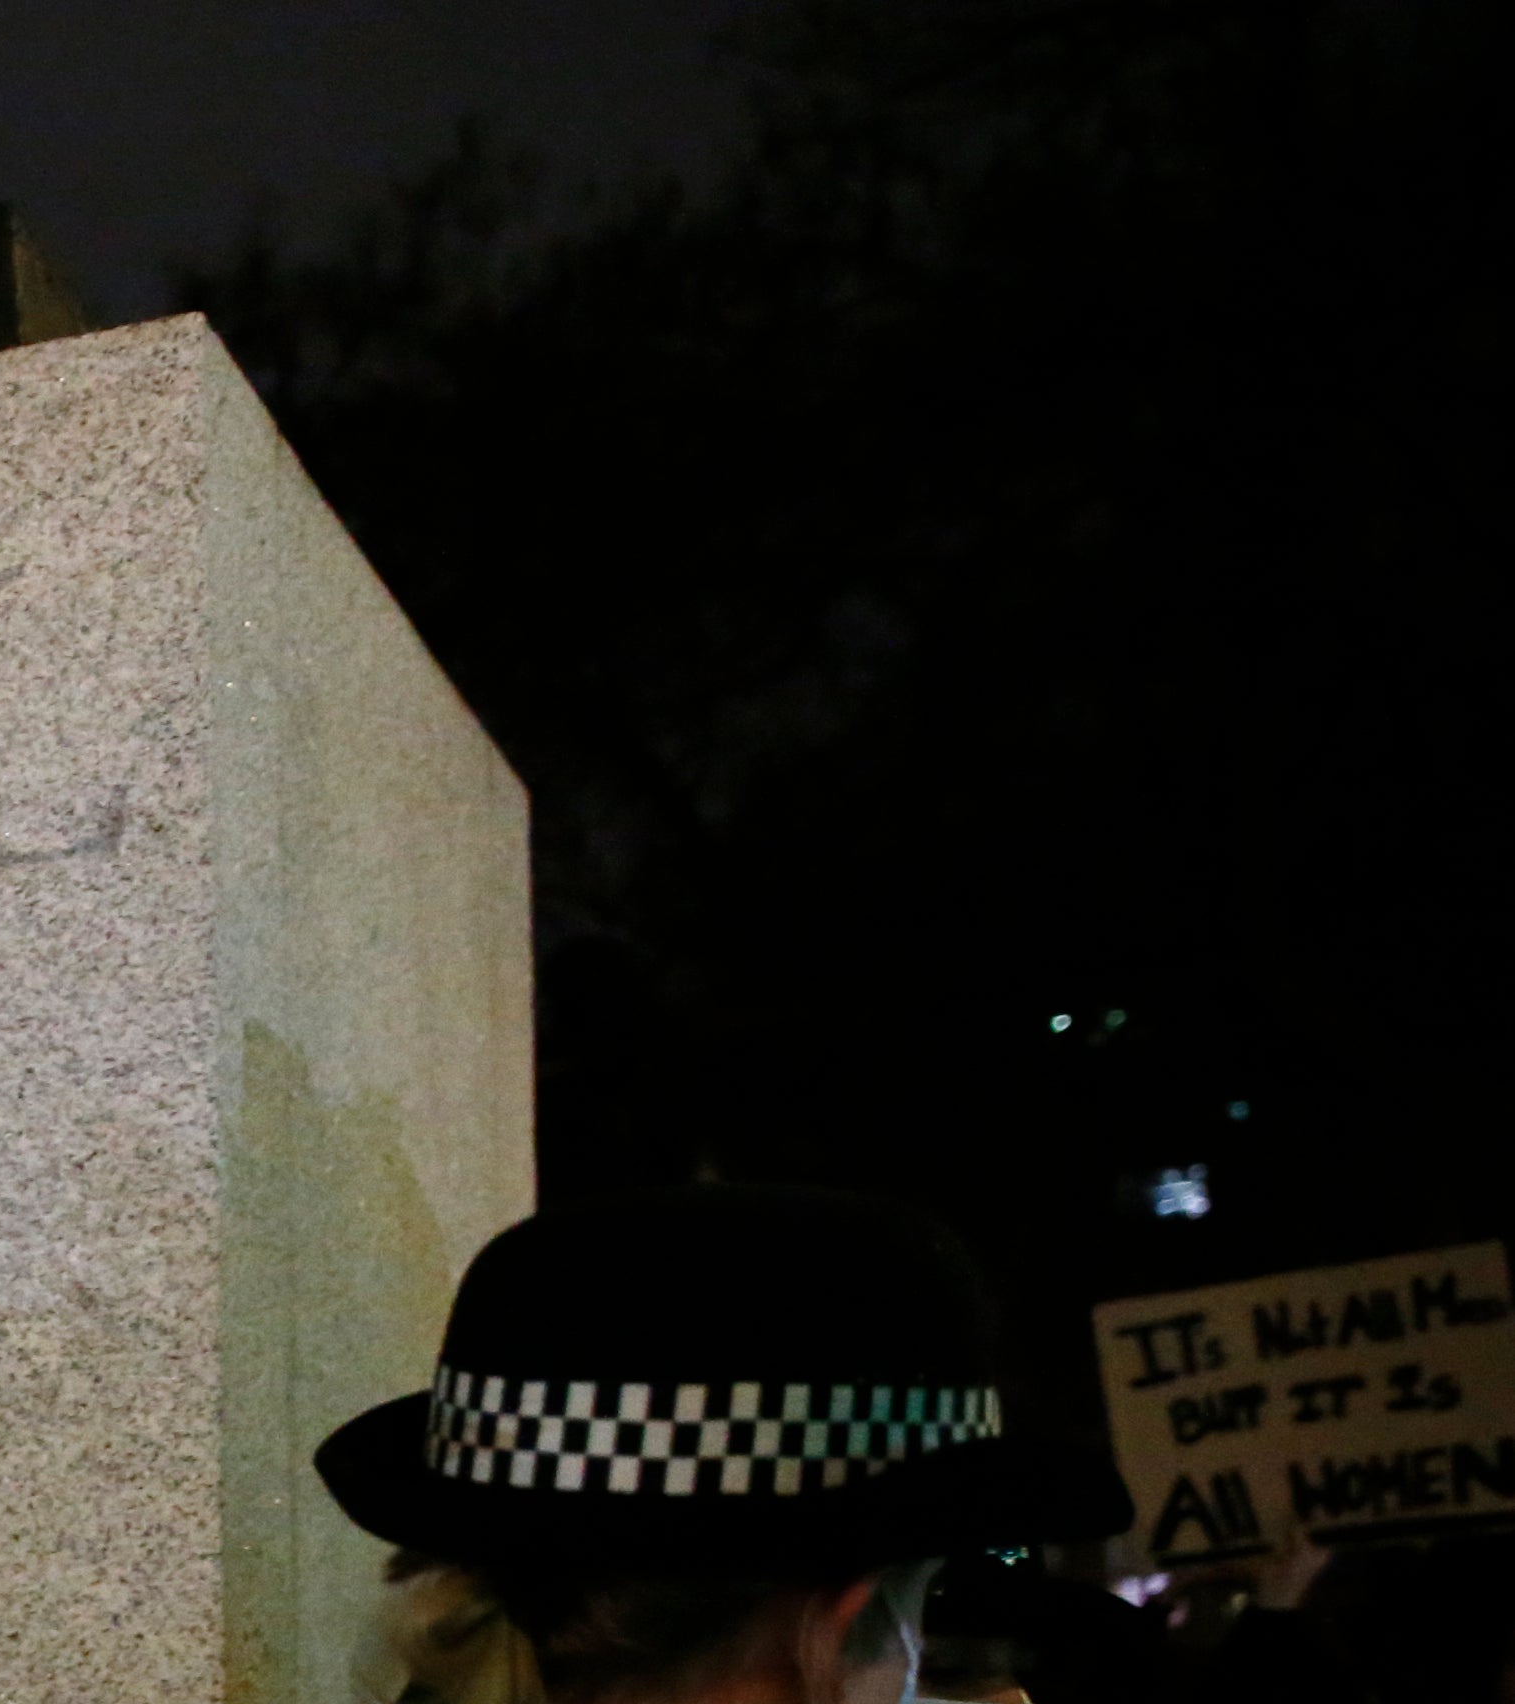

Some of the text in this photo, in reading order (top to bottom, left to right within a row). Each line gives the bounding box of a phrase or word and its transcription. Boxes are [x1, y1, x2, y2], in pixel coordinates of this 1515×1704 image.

[1170, 1383, 1266, 1446] BUT
[1288, 1376, 1365, 1424] IT
[1288, 1437, 1515, 1523] WOMEN
